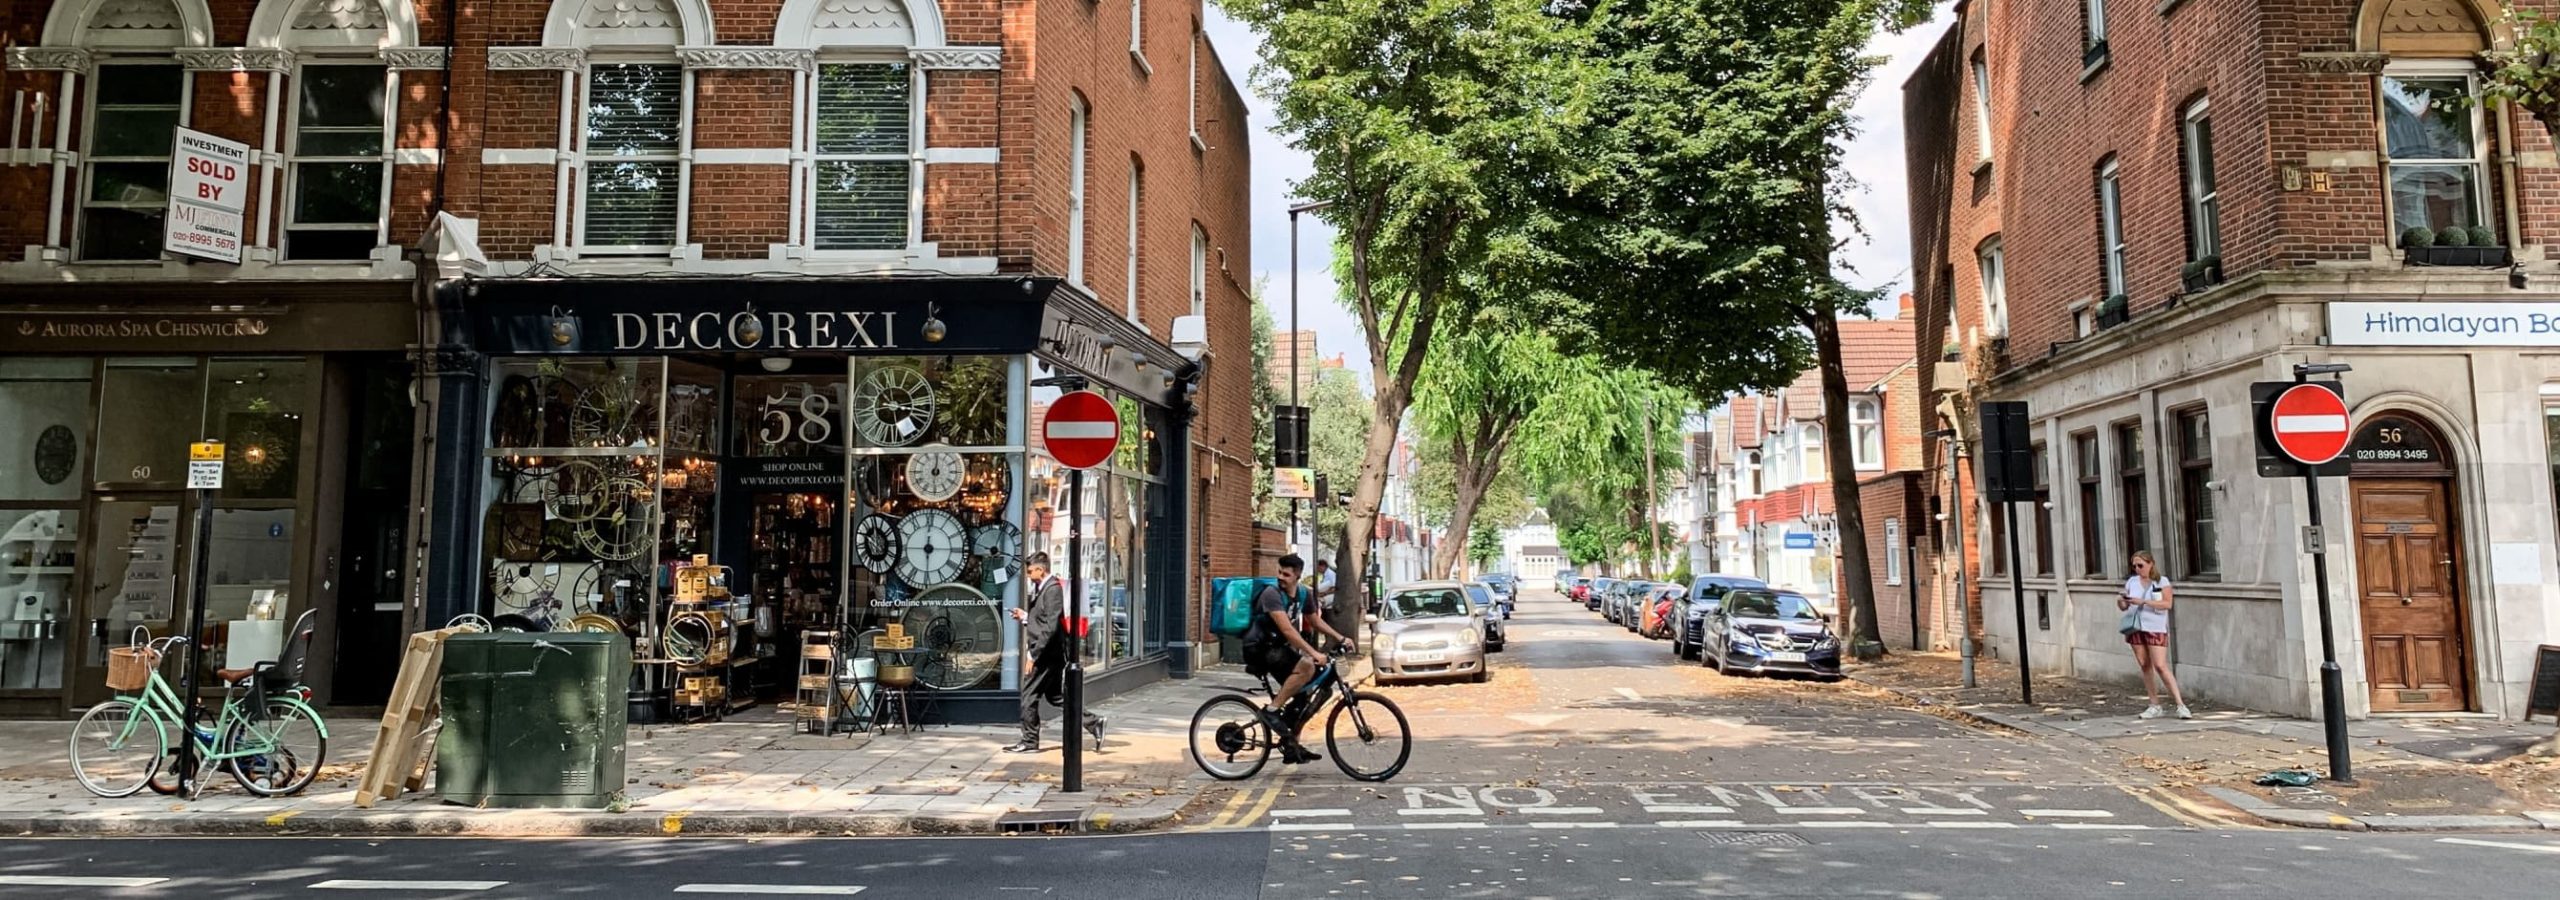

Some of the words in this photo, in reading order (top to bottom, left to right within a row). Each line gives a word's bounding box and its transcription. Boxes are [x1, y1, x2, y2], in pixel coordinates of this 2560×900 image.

[182, 136, 244, 159] INVESTMENT
[187, 157, 236, 181] SOLD
[198, 182, 223, 201] BY
[195, 224, 237, 238] COMMERCIAL
[215, 237, 236, 251] 5678
[612, 312, 899, 350] DECOREXI
[2365, 311, 2519, 338] Himalayan
[760, 391, 832, 444] 58
[2380, 428, 2402, 444] 56
[2356, 449, 2375, 460] 020
[2377, 449, 2401, 460] 8994
[2403, 449, 2429, 460] 3495
[132, 465, 151, 479] 60
[762, 462, 788, 472] SHOP
[788, 462, 825, 471] ONLINE
[870, 598, 893, 608] Order
[894, 598, 920, 608] Online
[1402, 786, 1558, 809] NO
[1631, 785, 1995, 809] ENTRY
